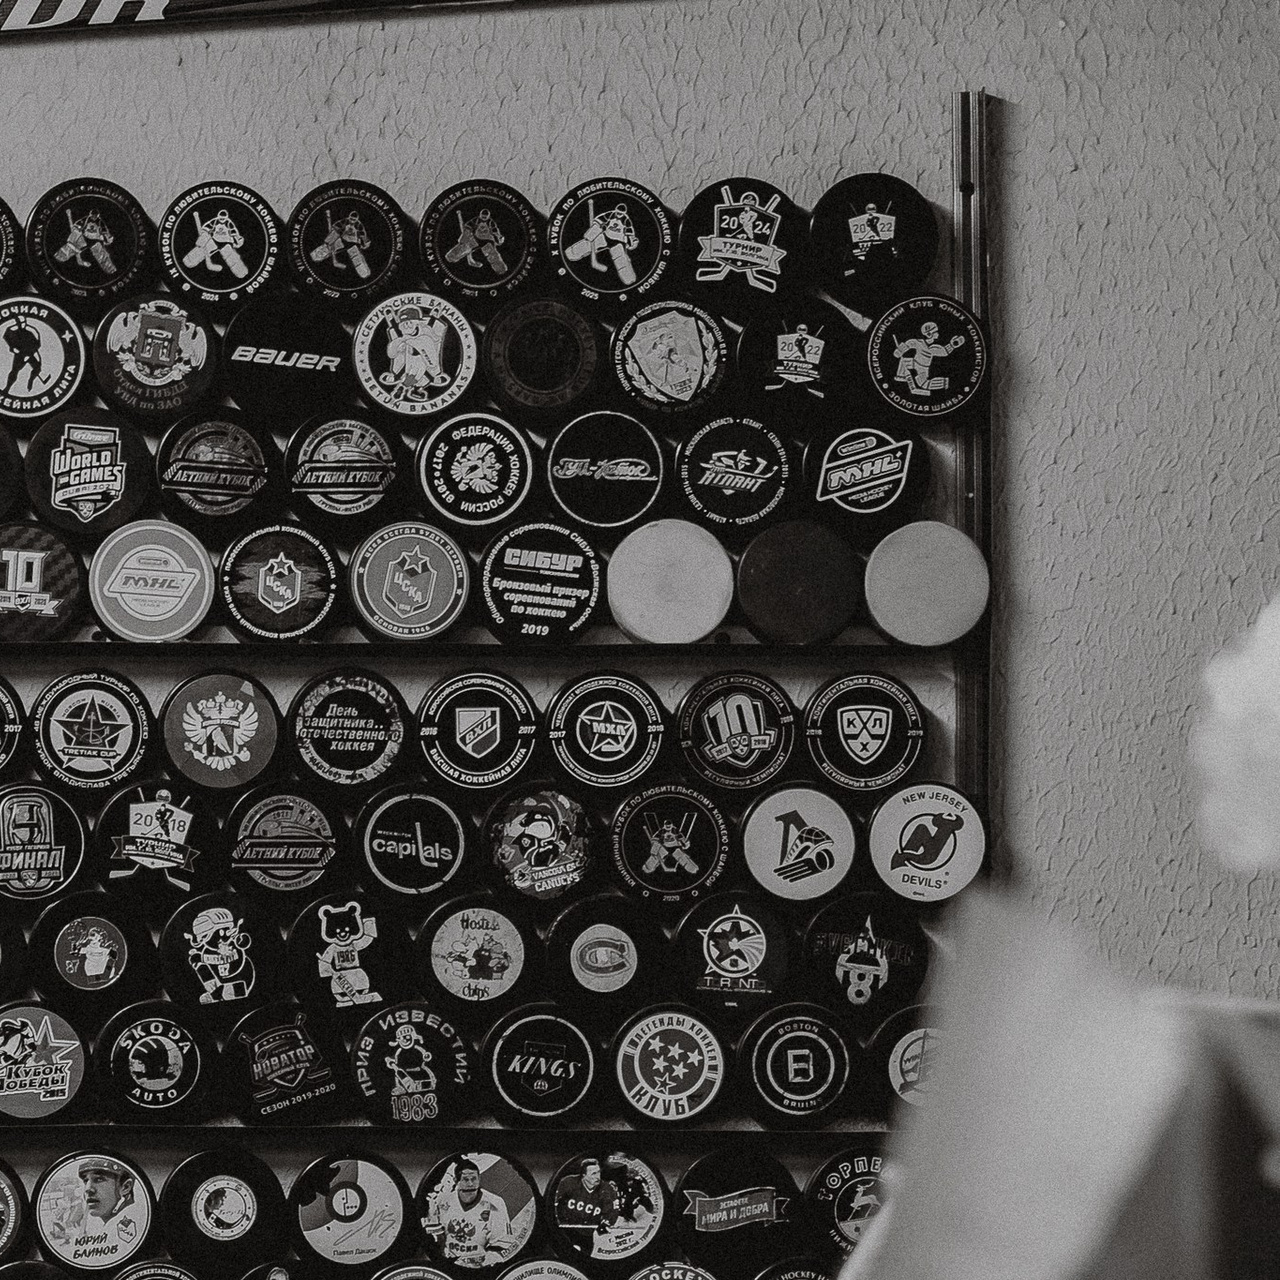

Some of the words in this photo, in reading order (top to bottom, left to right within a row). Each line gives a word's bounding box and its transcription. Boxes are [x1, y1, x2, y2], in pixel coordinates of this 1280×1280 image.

[550, 213, 565, 244] КУБОК
[576, 181, 655, 204] ЛЮБИТЕЛЬСКОМУ
[654, 206, 672, 244] ХОККЕЮ
[162, 232, 172, 265] КУБОК
[174, 186, 258, 217] ЛЮБИТЕЛЬСКОМУ
[256, 202, 277, 244] ХОККЕЮ
[231, 346, 341, 372] BAUER
[53, 364, 76, 397] ЛИГА
[409, 374, 468, 413] BANANAS
[451, 425, 514, 453] ФЕДЕРАЦИЯ
[504, 454, 520, 497] ХОККЕЯ
[827, 455, 901, 490] MHL
[504, 548, 584, 570] СИБУР
[121, 576, 186, 590] MHL
[492, 577, 552, 595] Бронзовый
[503, 591, 577, 609] соревнований
[521, 624, 549, 636] 2019
[326, 704, 359, 717] День
[330, 740, 375, 751] хоккея
[821, 762, 866, 788] РЕГУЛЯРНЫЙ
[902, 792, 926, 806] NEW
[928, 791, 969, 814] JERSEY
[901, 873, 942, 890] DEVILS
[633, 1015, 686, 1042] ЛЕГЕНДЫ
[777, 1023, 820, 1035] BOSTON
[6, 1063, 66, 1081] КУБОК
[252, 1045, 315, 1080] НОВАТОР
[131, 1088, 178, 1102] AUTO
[260, 1100, 290, 1116] СЕЗОН
[290, 1083, 336, 1105] 2019-2020
[630, 1082, 690, 1116] КЛУБ
[391, 1093, 439, 1122] 1983
[74, 1232, 108, 1247] ЮРИЙ
[73, 1244, 118, 1259] БЛИНОВ
